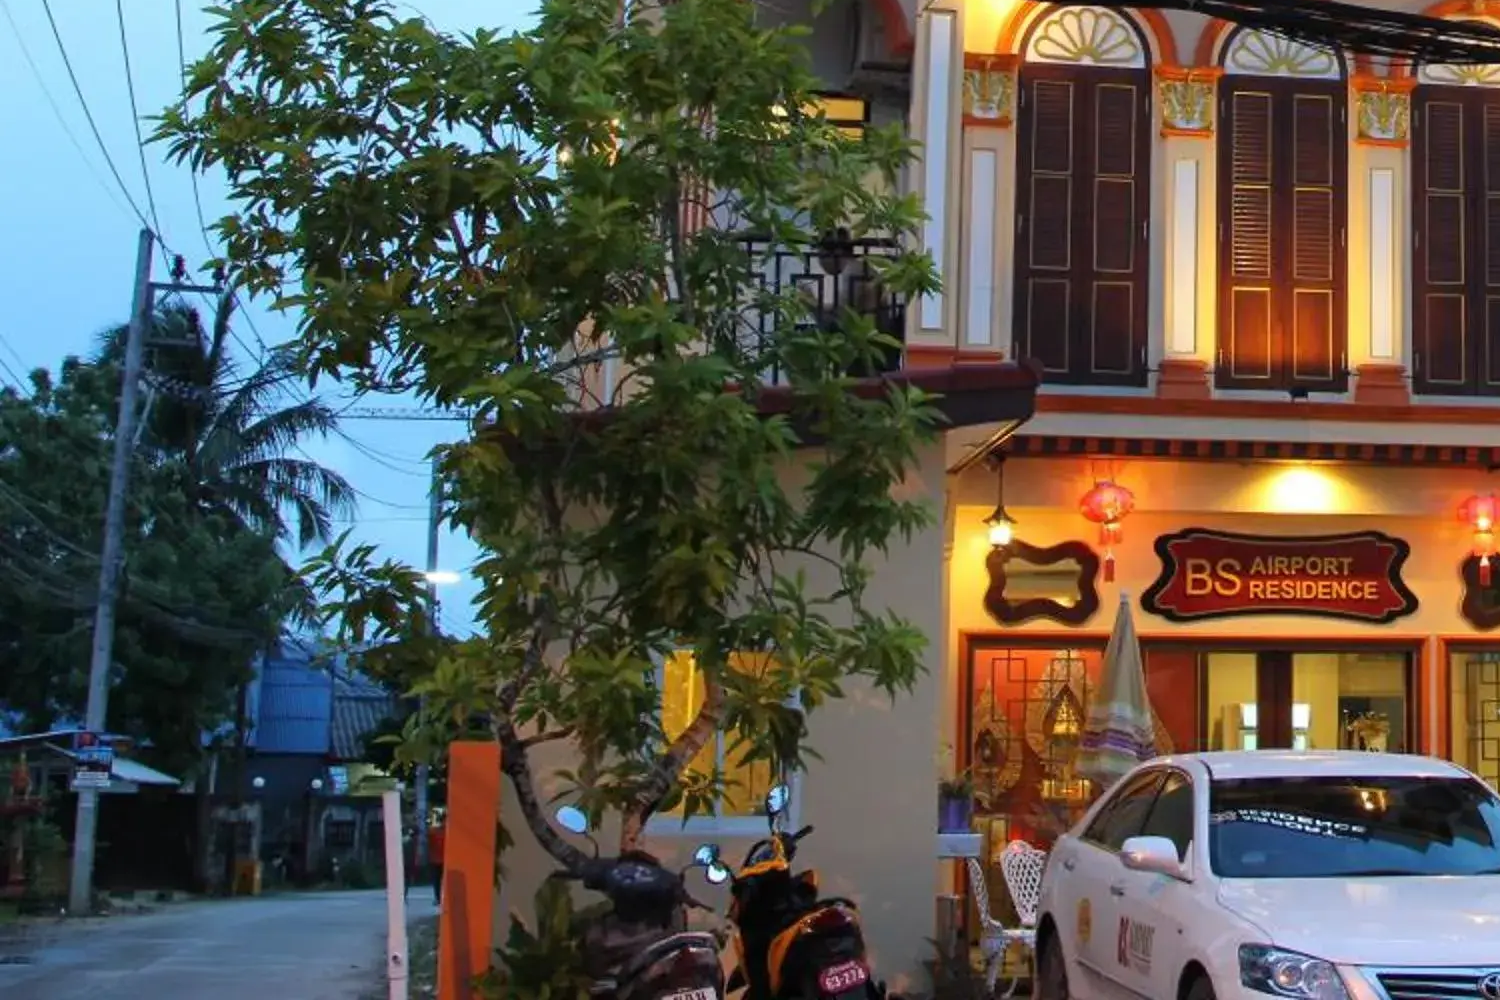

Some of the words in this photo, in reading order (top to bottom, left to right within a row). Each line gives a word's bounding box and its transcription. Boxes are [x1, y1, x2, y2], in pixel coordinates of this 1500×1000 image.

[1250, 556, 1354, 576] AIRPORT
[1185, 558, 1242, 597] BS
[1250, 580, 1380, 600] RESIDENCE
